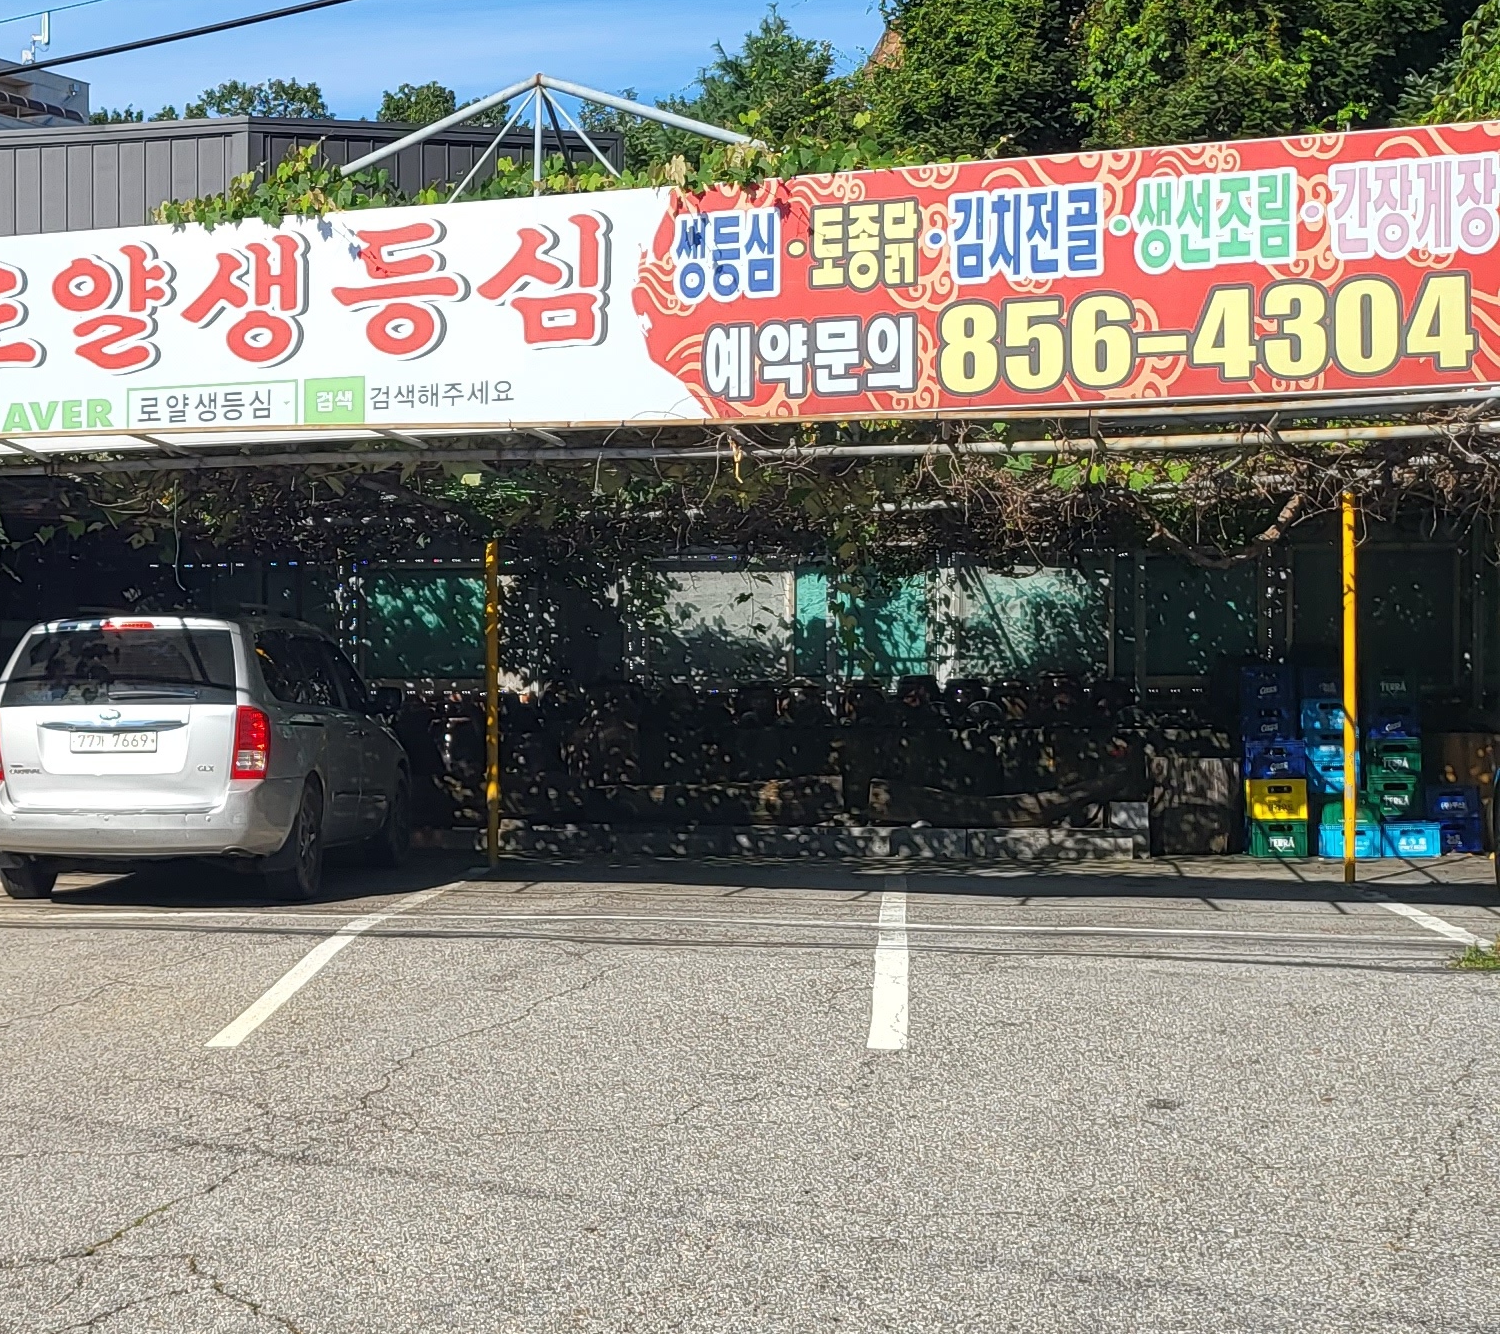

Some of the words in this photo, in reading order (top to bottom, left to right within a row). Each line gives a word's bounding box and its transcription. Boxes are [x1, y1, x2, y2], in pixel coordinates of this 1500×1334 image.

[811, 201, 918, 289] 토종닭
[952, 187, 1100, 279] 김치전골
[1137, 169, 1292, 270] 생선조림
[1334, 158, 1497, 254] 간장게장
[705, 316, 915, 400] 예약문의
[937, 274, 1477, 393] 856-4304
[136, 388, 272, 424] 로얄생등심
[315, 388, 355, 414] 검색
[368, 380, 516, 410] 검색해주세요
[112, 733, 149, 748] 7669
[1268, 836, 1296, 850] TERRA
